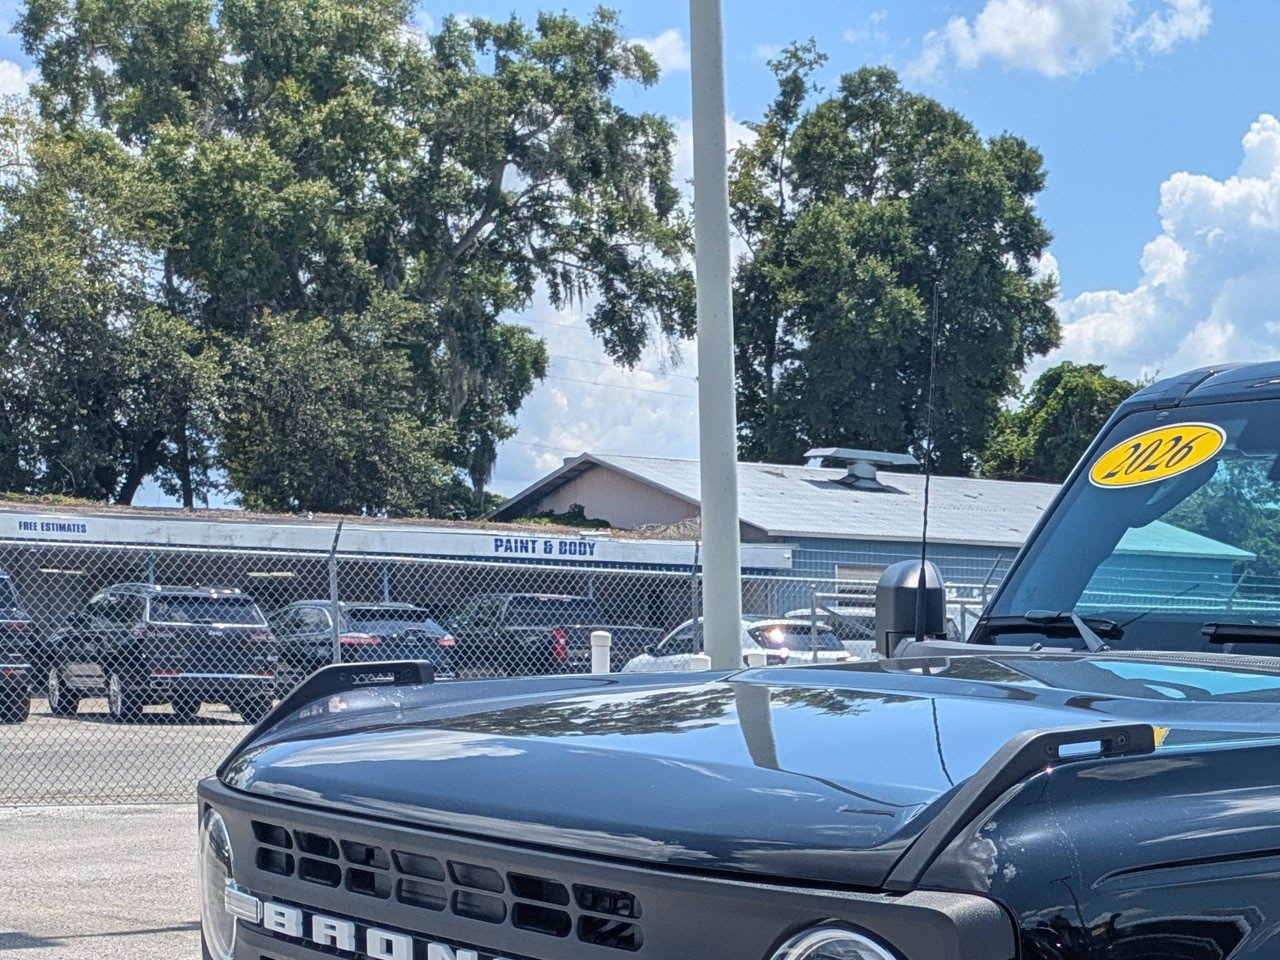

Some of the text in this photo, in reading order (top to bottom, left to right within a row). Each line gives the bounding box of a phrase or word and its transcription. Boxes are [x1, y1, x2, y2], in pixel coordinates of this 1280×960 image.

[1101, 432, 1209, 480] 2026
[19, 521, 87, 533] FREE ESTIMATES
[494, 538, 596, 556] PAINT & BODY
